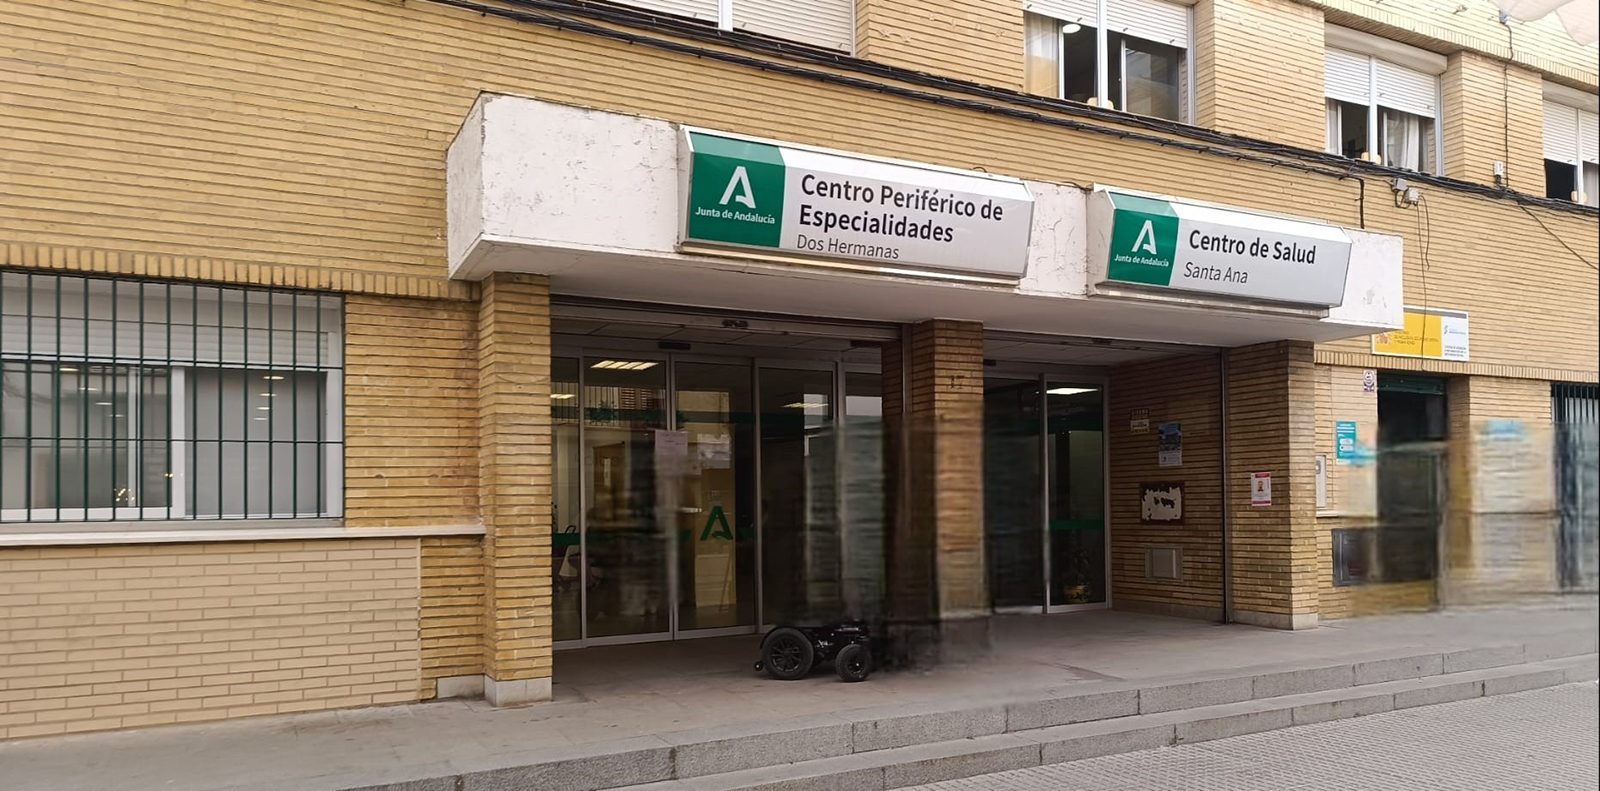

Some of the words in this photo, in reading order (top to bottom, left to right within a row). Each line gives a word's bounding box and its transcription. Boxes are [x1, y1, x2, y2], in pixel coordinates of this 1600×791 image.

[801, 174, 874, 203] Centro
[880, 185, 976, 217] Periférico
[980, 199, 1003, 221] de
[695, 206, 720, 217] Junta
[721, 210, 733, 219] de
[734, 211, 775, 224] Andalucía
[799, 204, 954, 242] Especialidades
[797, 234, 824, 251] Dos
[828, 238, 899, 259] Hermanas
[1189, 230, 1245, 255] Centro
[1249, 237, 1269, 258] de
[1272, 241, 1317, 264] Salud
[1114, 254, 1132, 263] Junta
[1132, 256, 1140, 264] de
[1140, 257, 1169, 267] Andalucía
[1184, 261, 1221, 281] Santa
[1223, 267, 1248, 284] Ana
